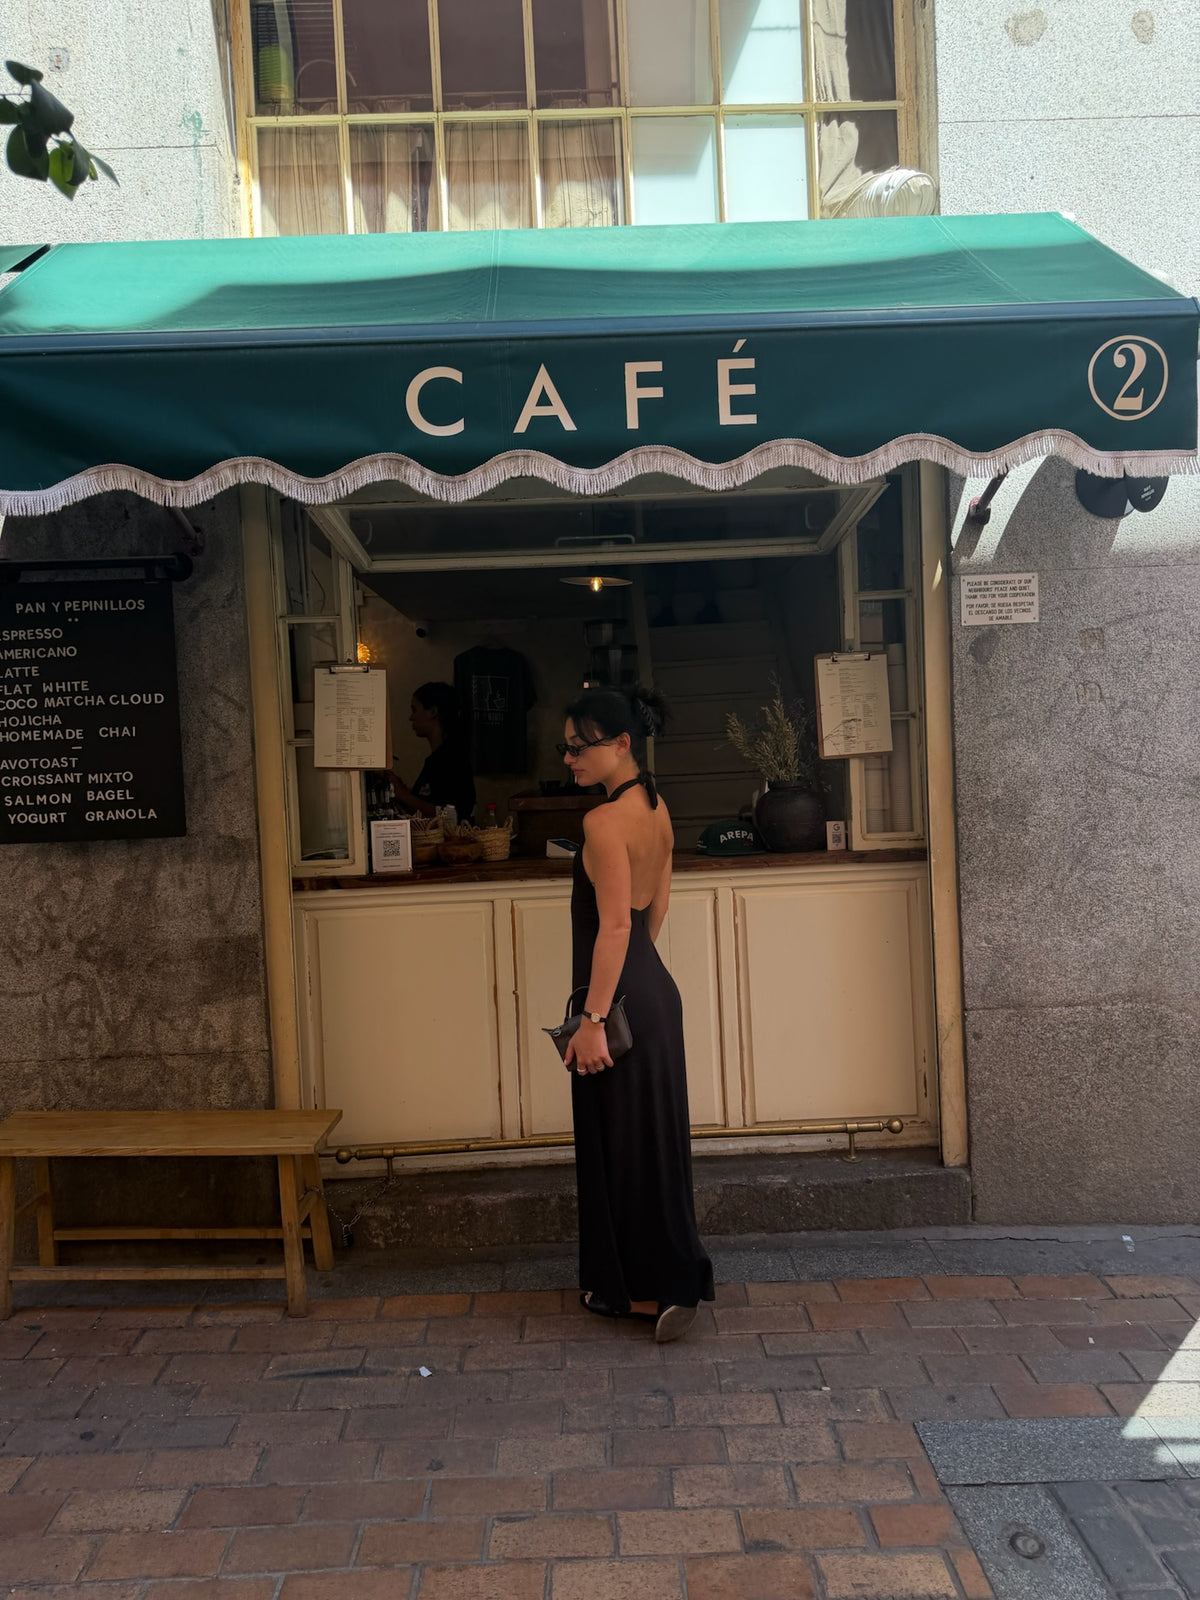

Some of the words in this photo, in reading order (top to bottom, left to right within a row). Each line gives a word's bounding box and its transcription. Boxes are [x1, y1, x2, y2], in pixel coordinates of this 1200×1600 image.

[1113, 343, 1147, 410] 2
[405, 339, 758, 437] CAFÉ
[16, 602, 46, 614] PAN
[52, 601, 61, 613] Y
[64, 599, 146, 613] PEPINILLOS
[0, 628, 63, 641] SPRESSO
[42, 681, 90, 694] WHITE
[0, 698, 38, 710] COCO
[44, 695, 105, 708] MATCHA
[109, 693, 165, 706] CLOUD
[0, 714, 62, 728] HOJICHA
[0, 729, 84, 742] HOMEMADE
[99, 726, 137, 738] CHAI
[0, 757, 79, 770] AVOTOAST
[1, 772, 83, 787] CROISSANT
[88, 771, 134, 785] MIXTO
[4, 793, 72, 807] SALMON
[86, 789, 134, 802] BAGEL
[8, 812, 67, 825] YOGURT
[85, 808, 158, 822] GRANOLA
[719, 830, 754, 844] AREPA
